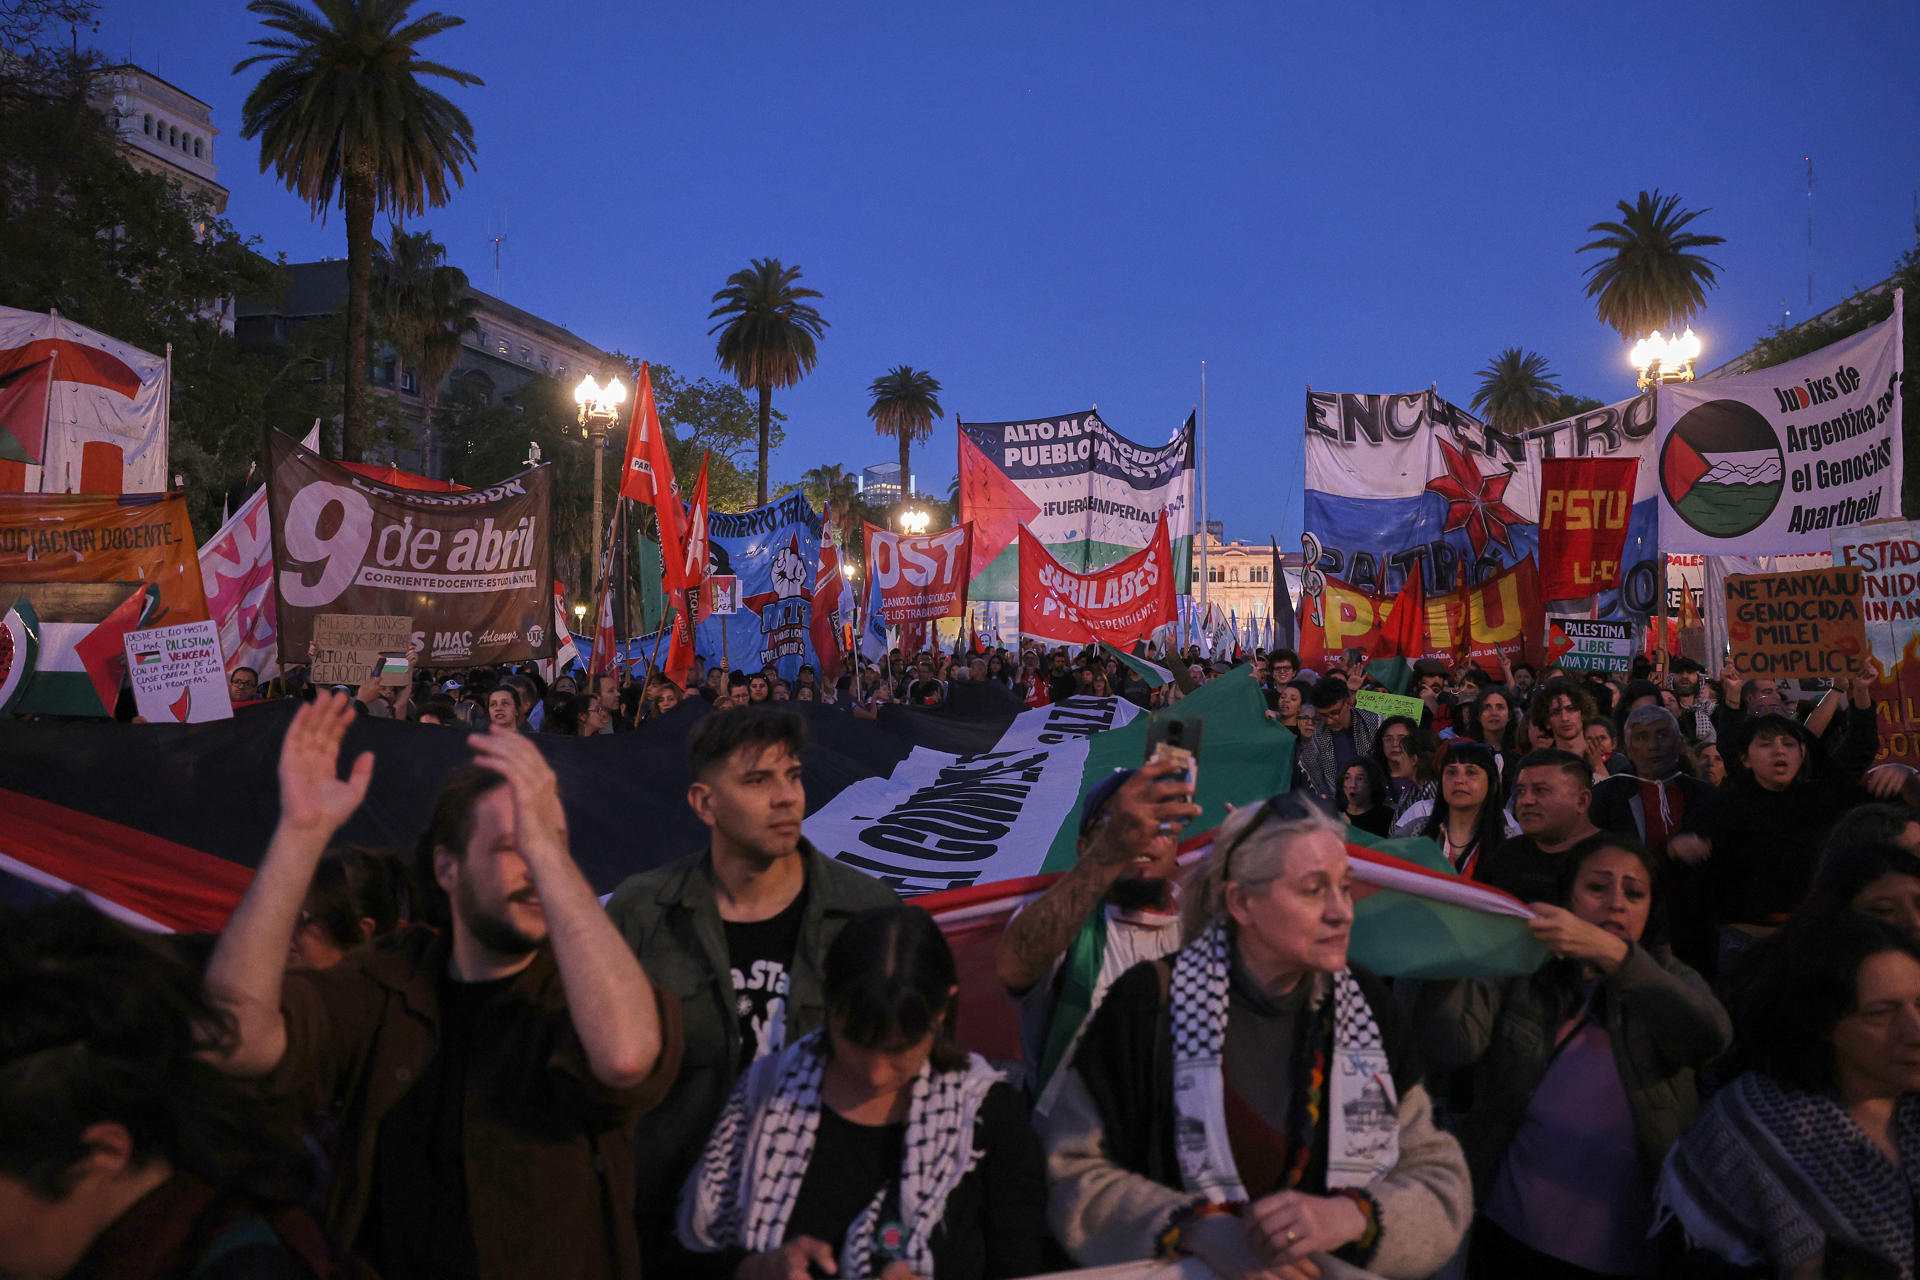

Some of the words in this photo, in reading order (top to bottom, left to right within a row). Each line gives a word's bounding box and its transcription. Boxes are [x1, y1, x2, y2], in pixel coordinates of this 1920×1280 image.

[1835, 365, 1861, 396] de
[1003, 421, 1054, 443] ALTO
[1058, 419, 1082, 437] AL
[1786, 403, 1877, 454] Argentina
[1004, 438, 1090, 467] PUEBLO
[1791, 463, 1812, 493] el
[1542, 489, 1628, 531] PSTU
[1787, 485, 1882, 535] Apartheid
[279, 480, 375, 608] 9
[375, 516, 441, 570] de
[446, 516, 537, 572] abril
[870, 528, 965, 589] OST
[1843, 540, 1920, 573] ESTAD
[364, 571, 437, 588] CORRIENTE
[1726, 573, 1859, 600] NETANYAJU
[882, 592, 929, 608] GANIZACIÓN
[1043, 597, 1079, 623] PTS
[1737, 598, 1859, 623] GENOCIDA
[891, 609, 905, 620] LOS
[155, 631, 166, 639] EL
[184, 625, 209, 634] HASTA
[432, 630, 473, 649] MAC
[477, 629, 519, 645] Ademys
[1756, 623, 1819, 646] MILEI
[130, 643, 139, 652] EL
[144, 642, 161, 651] MAR
[166, 637, 214, 651] PALESTINA
[314, 650, 342, 664] ALTO
[346, 651, 362, 665] AL
[1582, 656, 1590, 669] Y
[1592, 657, 1605, 671] EN
[1609, 658, 1629, 672] PAZ
[1733, 649, 1862, 674] COMPLICE
[132, 667, 147, 677] CON
[150, 665, 158, 674] LA
[162, 663, 190, 671] FUERZA
[136, 674, 160, 685] CLASE
[161, 670, 188, 681] OBRERA
[193, 667, 203, 675] ES
[140, 685, 146, 693] Y
[165, 675, 208, 689] FRONTERAS
